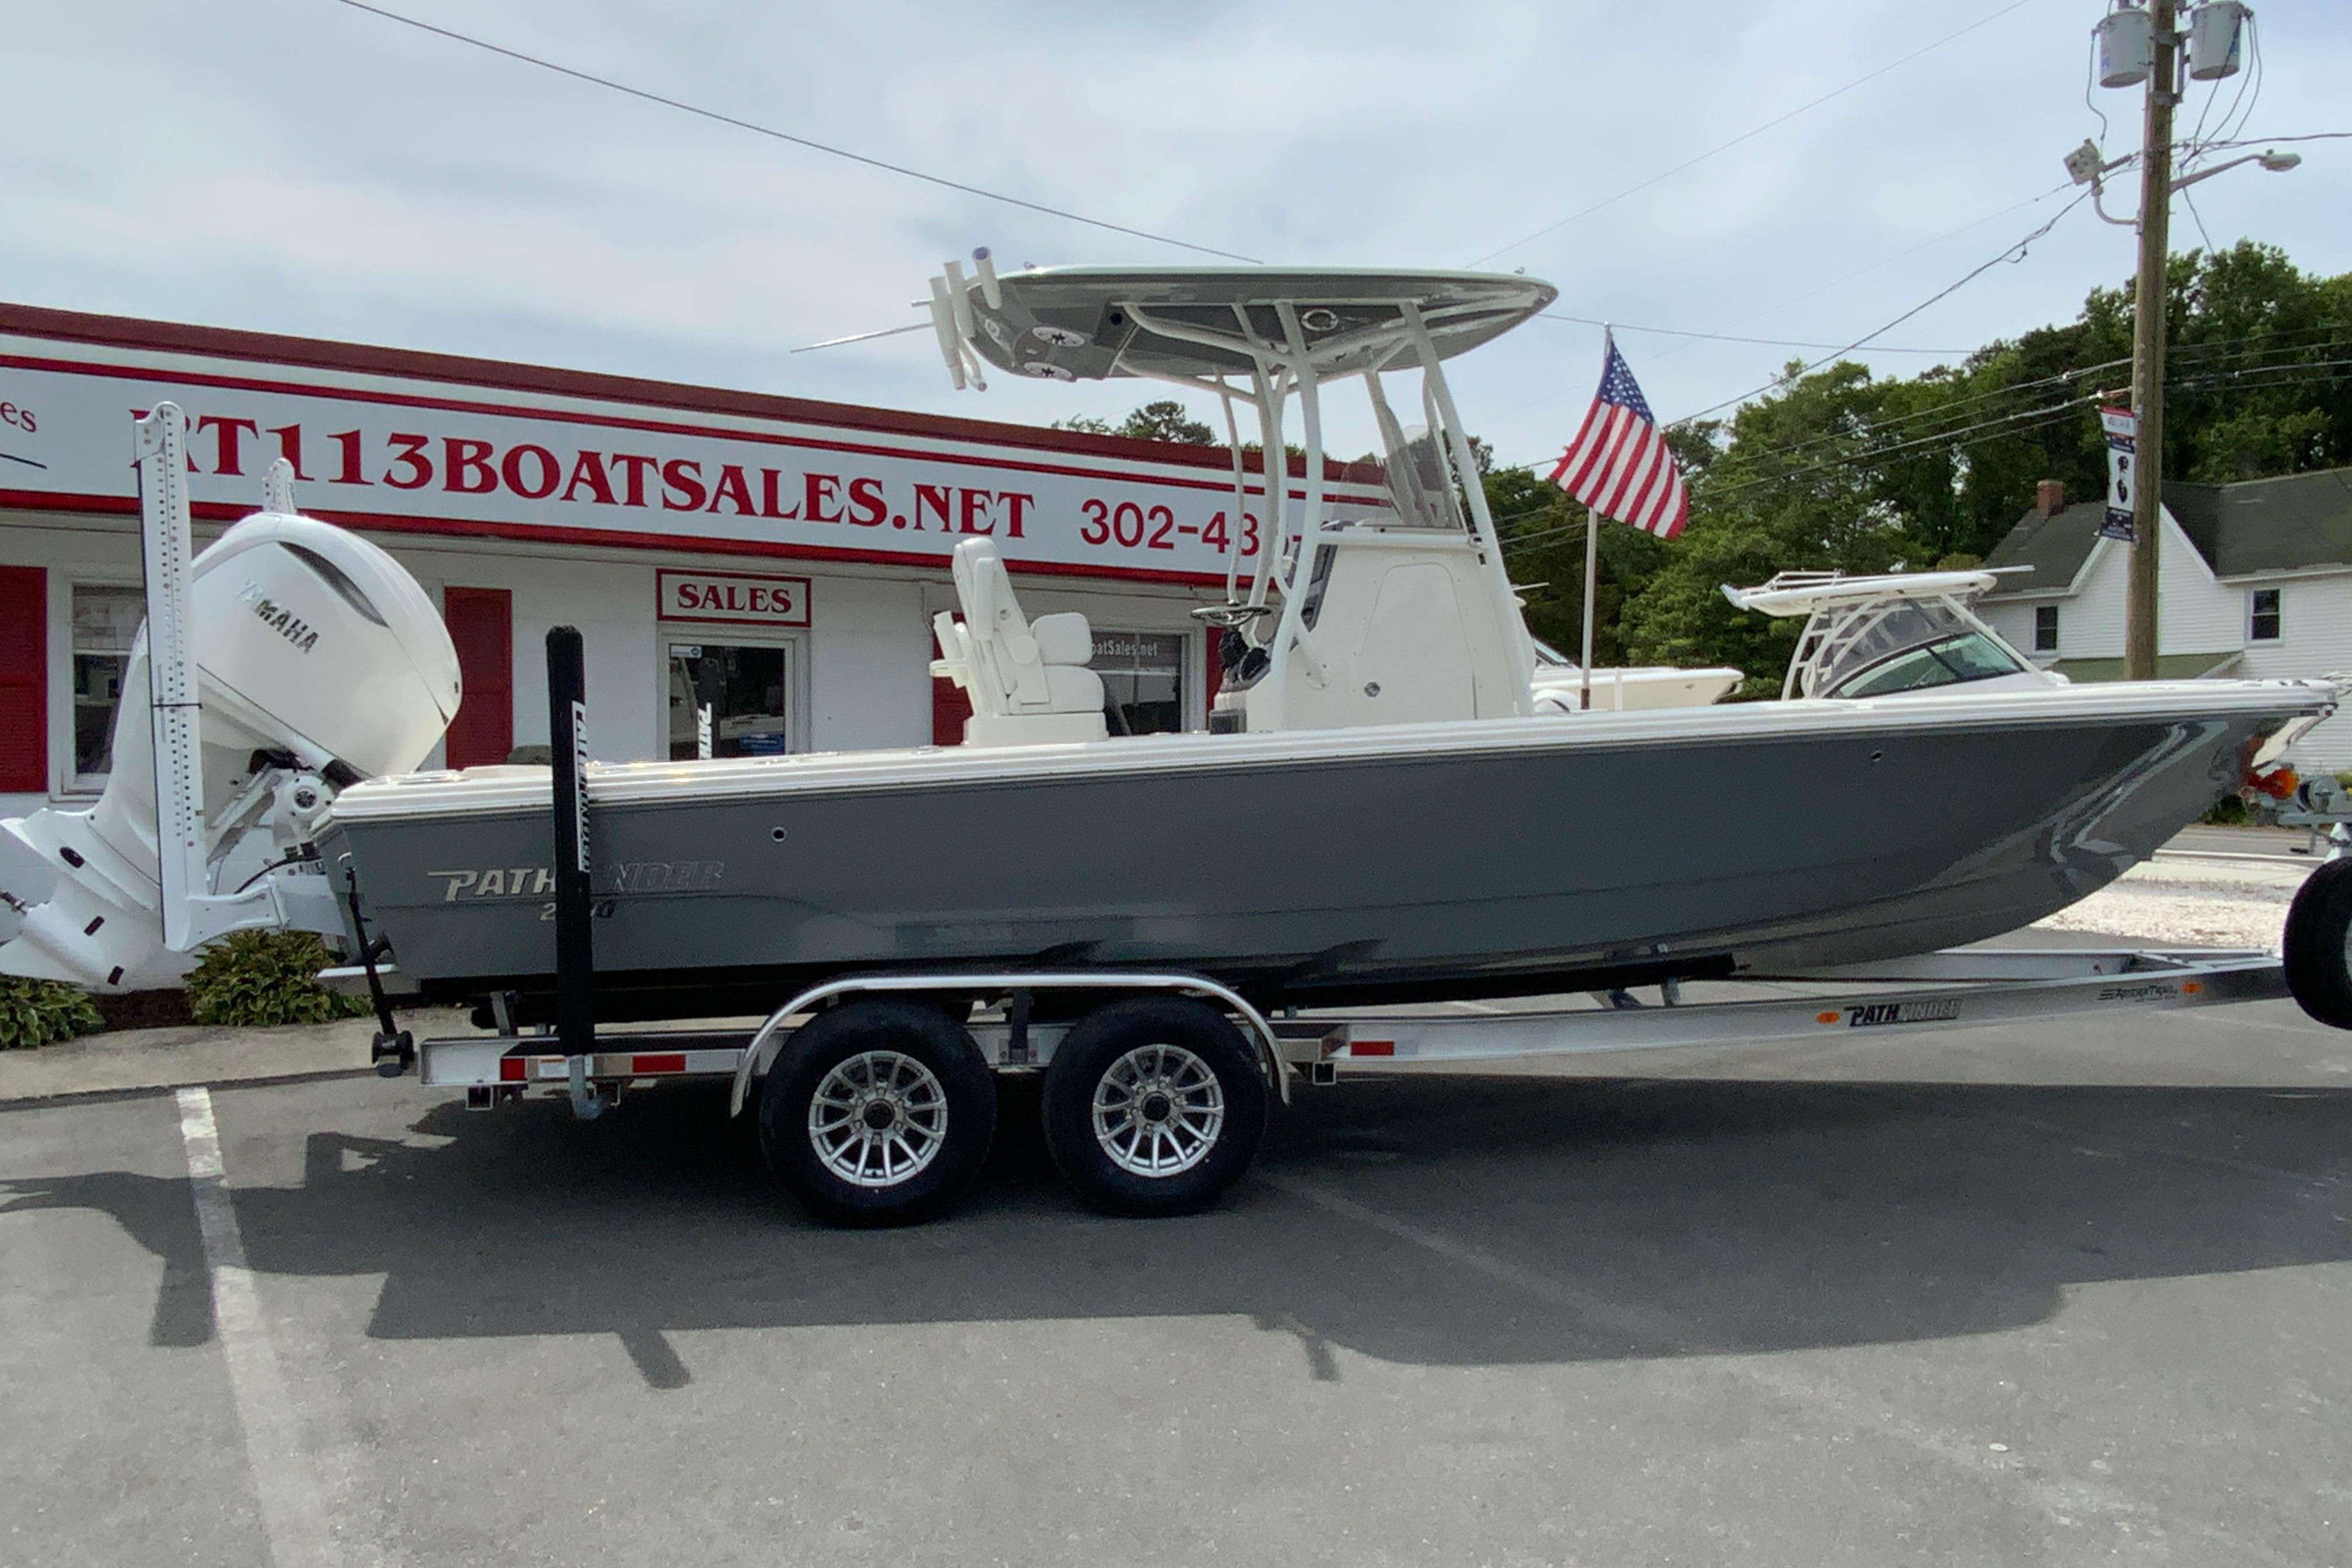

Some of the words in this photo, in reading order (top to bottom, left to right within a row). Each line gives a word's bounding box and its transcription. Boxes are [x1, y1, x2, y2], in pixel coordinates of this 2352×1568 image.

[0, 402, 37, 432] es
[1080, 499, 1302, 556] 302-43
[677, 583, 792, 614] SALES
[236, 578, 319, 654] YAMAHA
[1090, 639, 1158, 657] oatSales.net
[428, 860, 724, 902] PATHNDER
[540, 900, 616, 922] 20
